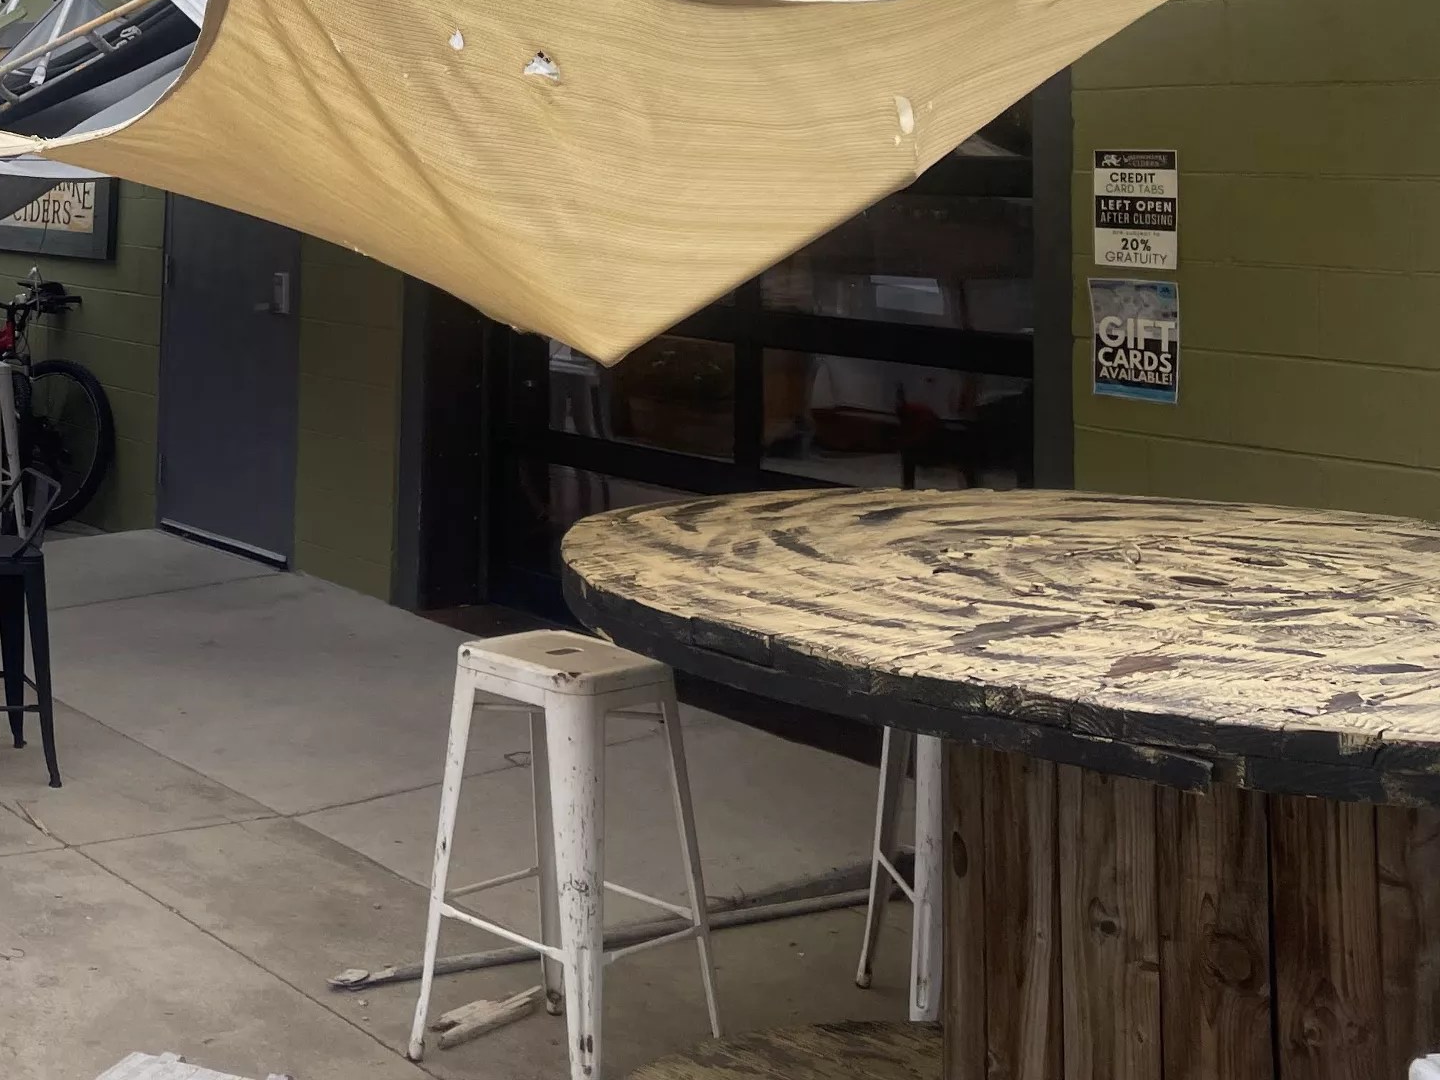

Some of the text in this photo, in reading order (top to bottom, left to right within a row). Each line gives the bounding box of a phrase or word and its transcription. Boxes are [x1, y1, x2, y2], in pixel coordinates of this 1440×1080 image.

[1110, 172, 1155, 183] CREDIT
[1105, 183, 1164, 195] CARD TABS
[1101, 199, 1172, 213] LEFT OPEN
[1100, 212, 1173, 226] AFTER CLOSING
[1121, 238, 1151, 251] 20%
[1105, 251, 1167, 265] GRATUITY
[1100, 315, 1175, 352] GIFT
[1098, 347, 1172, 373] CARDS
[1100, 366, 1173, 386] AVAILABLE!
